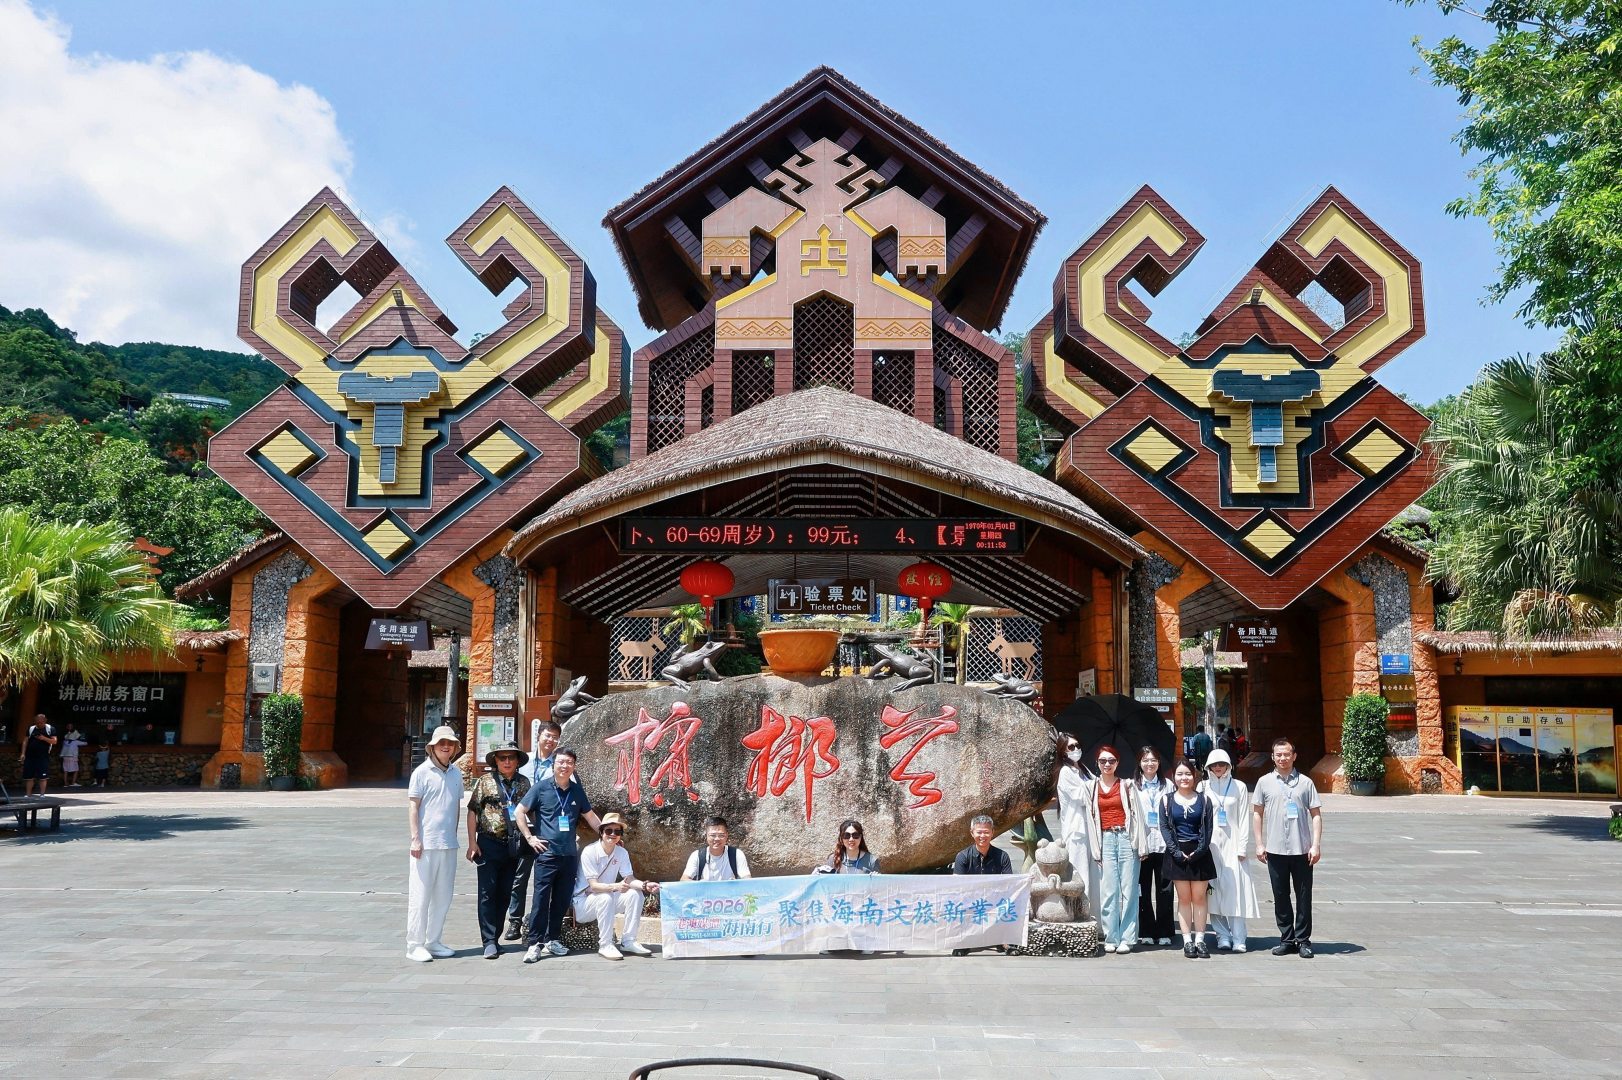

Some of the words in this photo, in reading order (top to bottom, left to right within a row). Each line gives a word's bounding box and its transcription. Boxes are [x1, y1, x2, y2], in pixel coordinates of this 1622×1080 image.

[804, 585, 868, 602] 验票处
[810, 603, 835, 611] Ticket
[836, 603, 862, 611] Check
[379, 624, 418, 634] 备用通道
[1237, 627, 1278, 636] 备用通道
[58, 685, 165, 702] 讲解服务窗口
[72, 704, 108, 712] Guided
[110, 705, 147, 713] Service
[1506, 715, 1564, 725] 自助存包
[703, 899, 745, 914] 2026
[777, 898, 1019, 927] 聚焦海南文旅新業態
